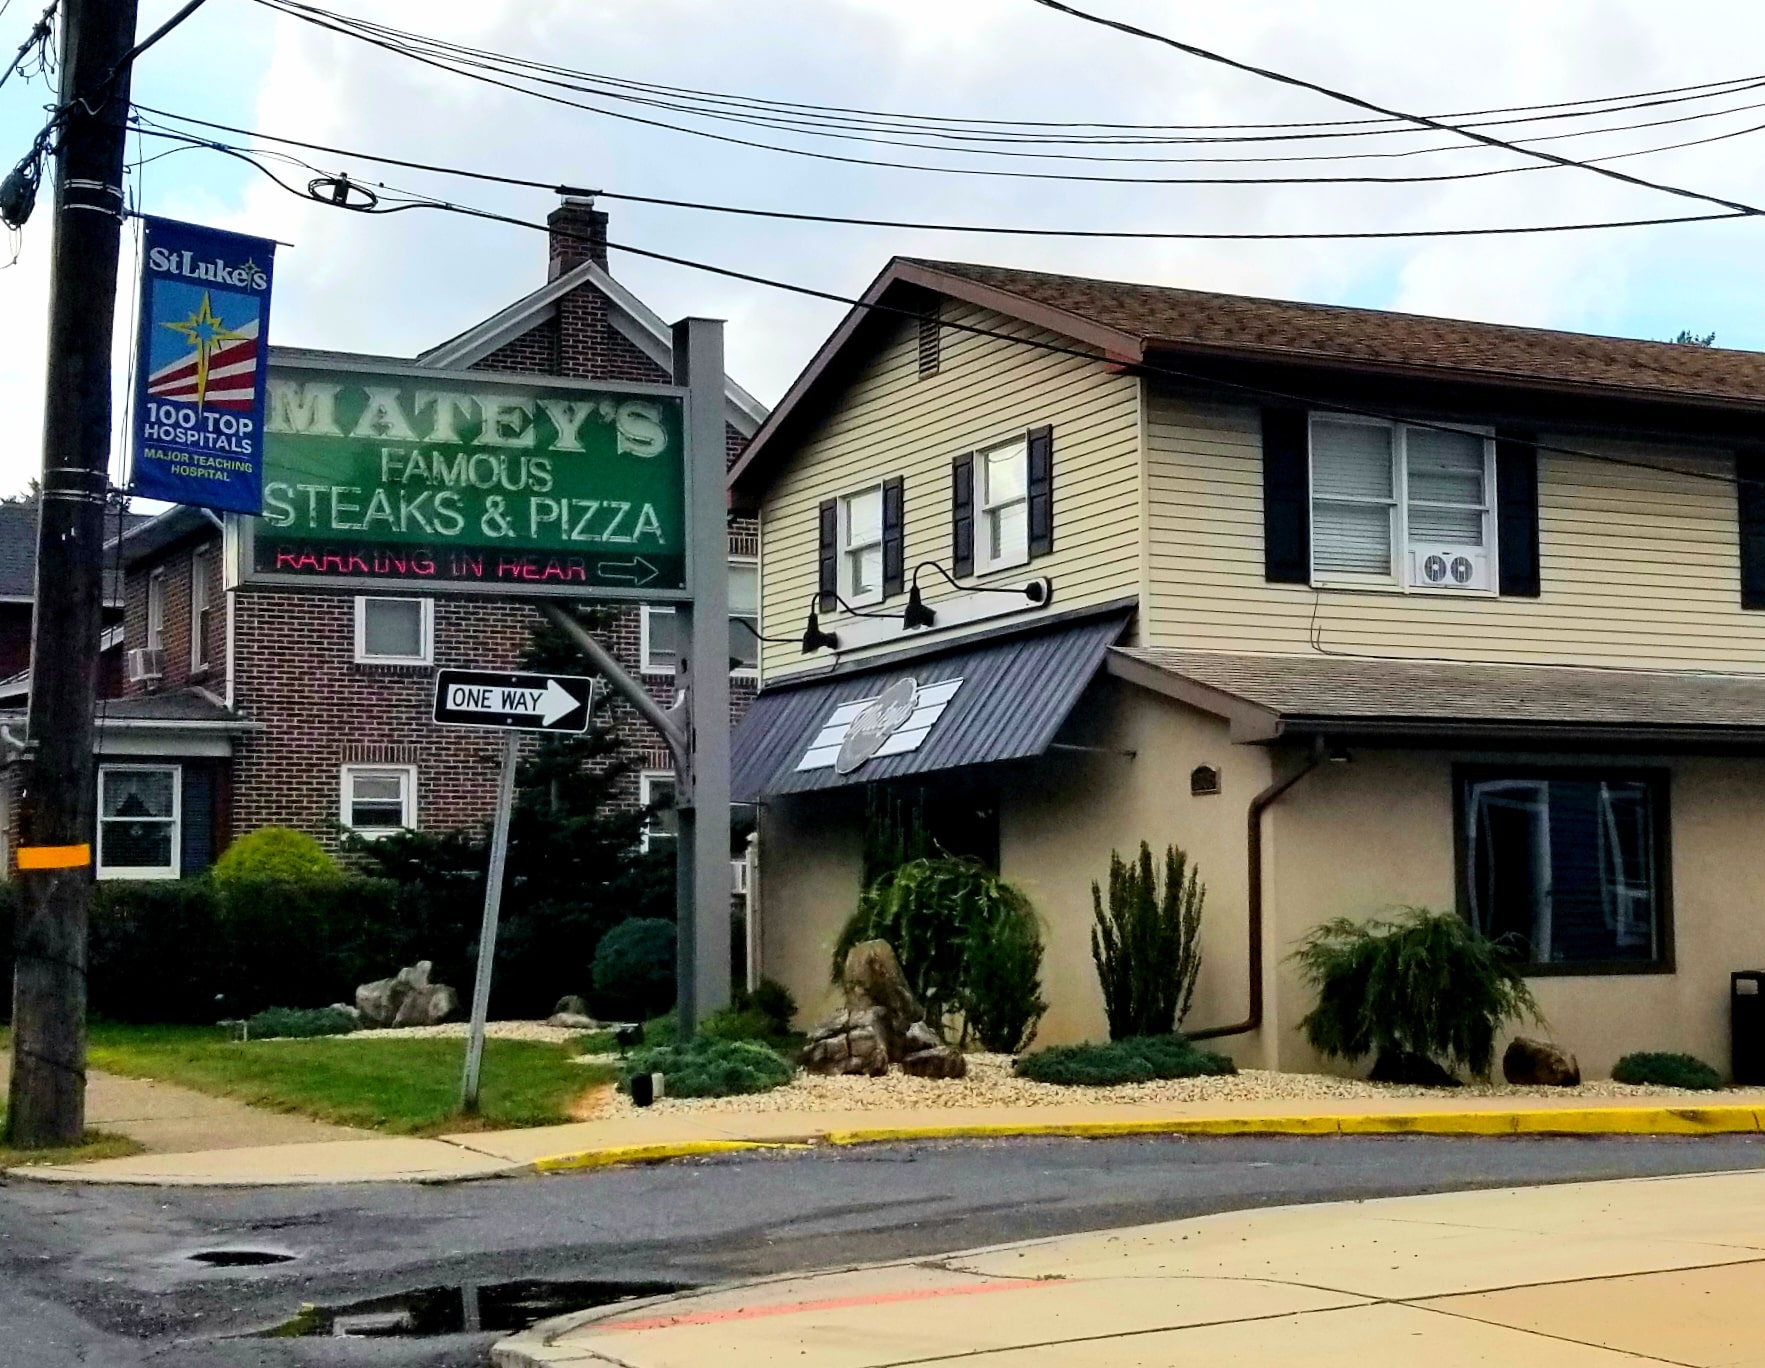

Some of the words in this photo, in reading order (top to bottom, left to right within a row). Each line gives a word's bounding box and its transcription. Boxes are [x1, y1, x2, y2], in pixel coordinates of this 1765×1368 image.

[147, 403, 196, 428] 100
[202, 412, 253, 437] TOP
[264, 380, 668, 458] MATEY'S
[144, 424, 252, 454] HOSPITALS
[144, 448, 189, 463] MAJOR
[192, 454, 253, 473] TEACHING
[170, 464, 230, 482] HOSPITAL
[381, 447, 554, 493] FAMOUS
[263, 481, 466, 536] STEAKS
[480, 494, 517, 539] &
[529, 497, 666, 546] PIZZA
[451, 552, 483, 577] IN
[498, 555, 587, 581] REAR
[453, 687, 494, 709] ONE
[501, 690, 543, 712] WAY
